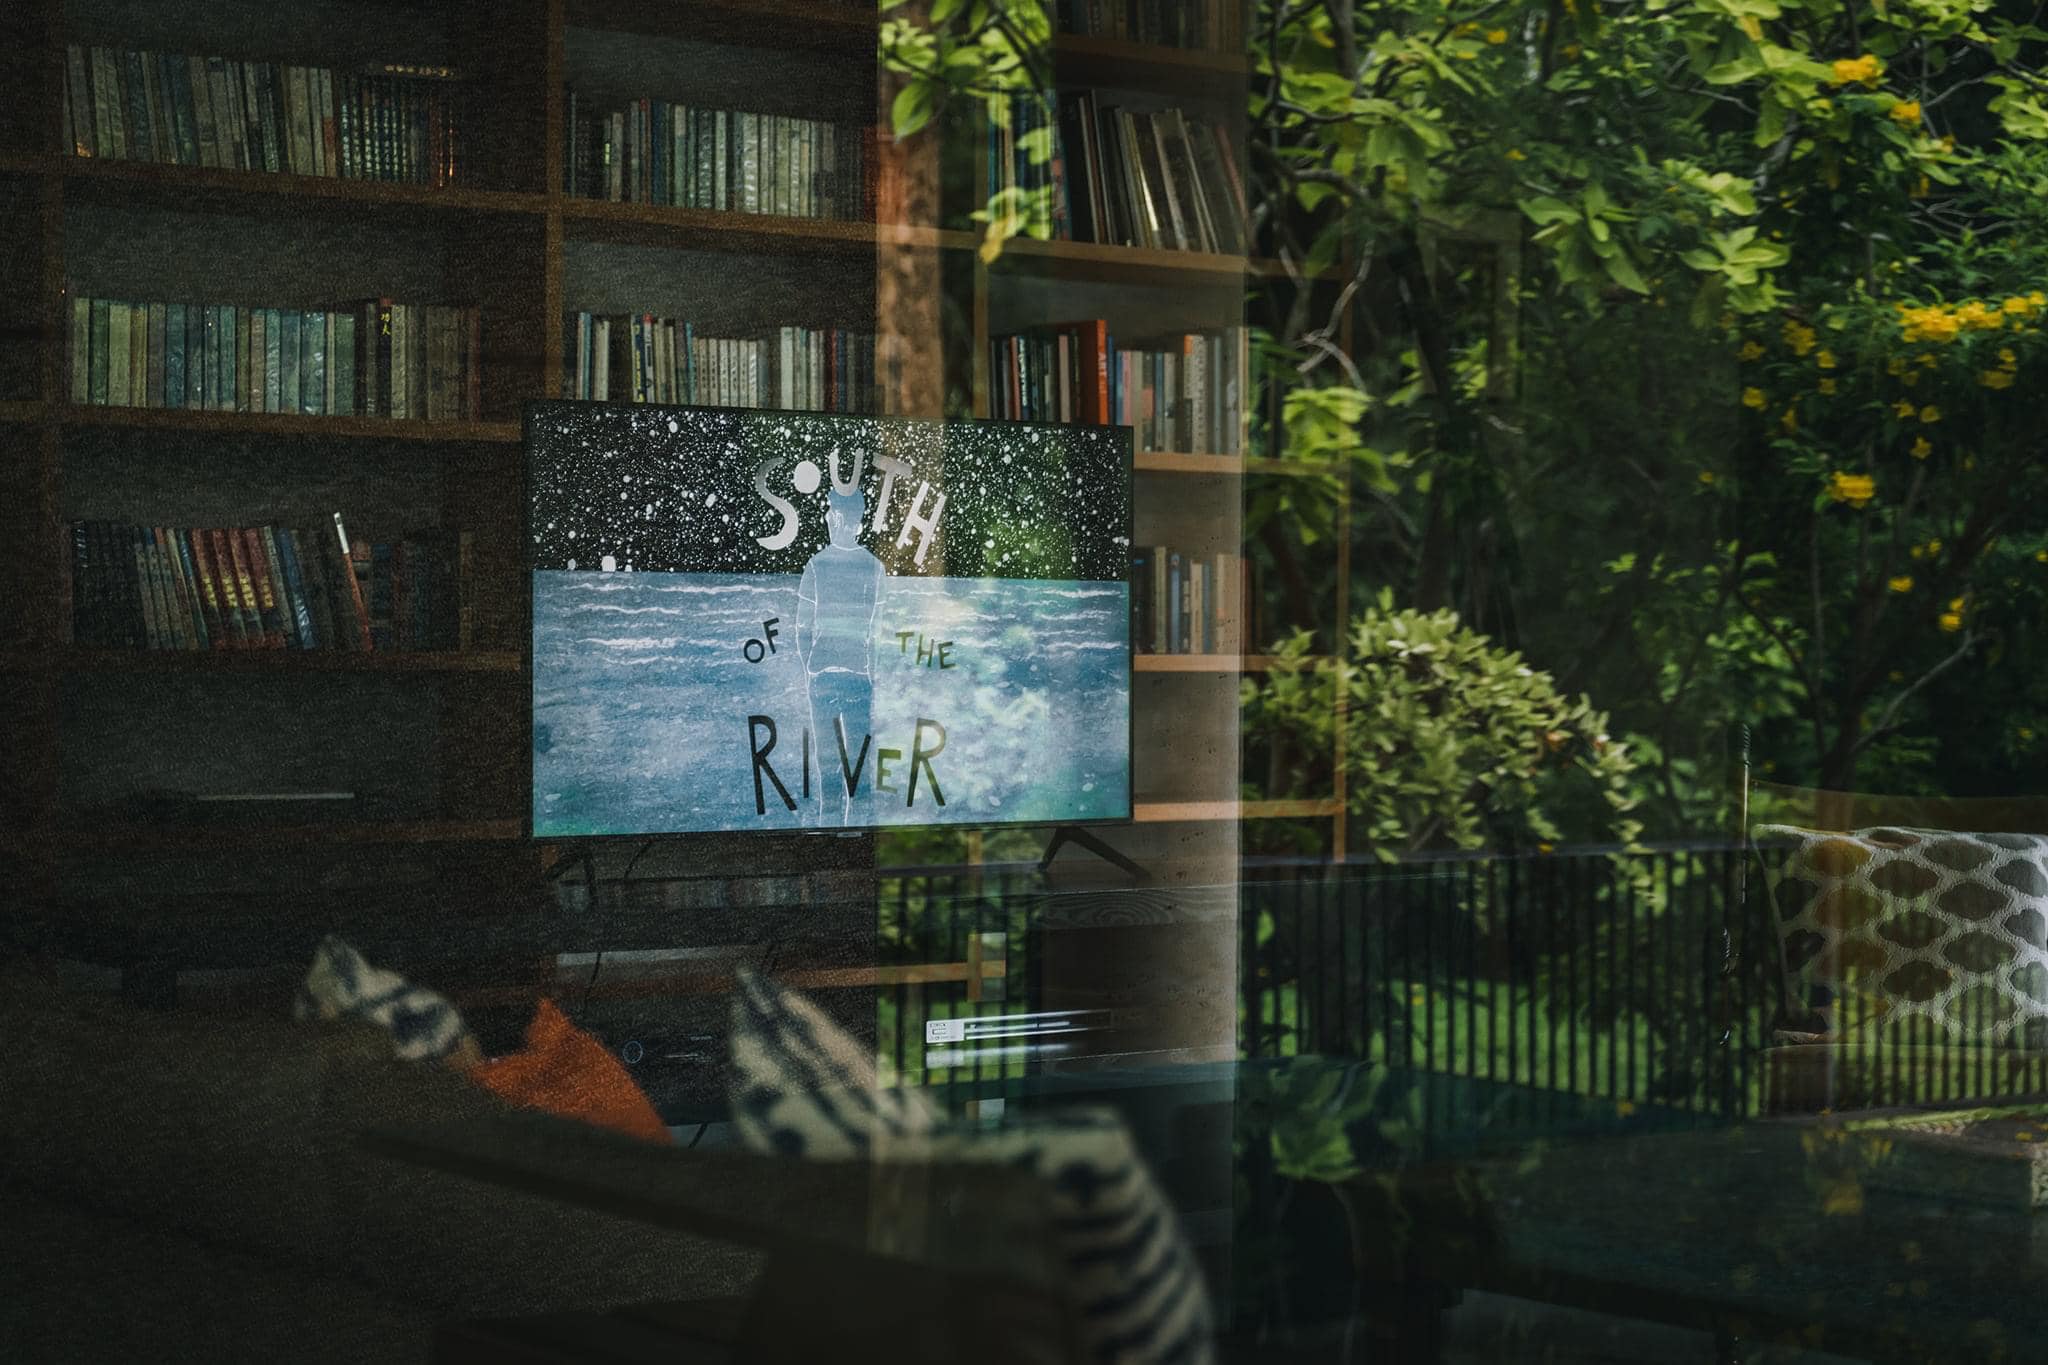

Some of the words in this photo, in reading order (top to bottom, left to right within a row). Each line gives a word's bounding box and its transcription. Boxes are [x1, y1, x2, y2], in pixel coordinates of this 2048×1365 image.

[755, 448, 947, 566] SOUTH
[744, 618, 780, 663] OF
[895, 631, 956, 669] THE
[748, 715, 946, 815] RIVER
